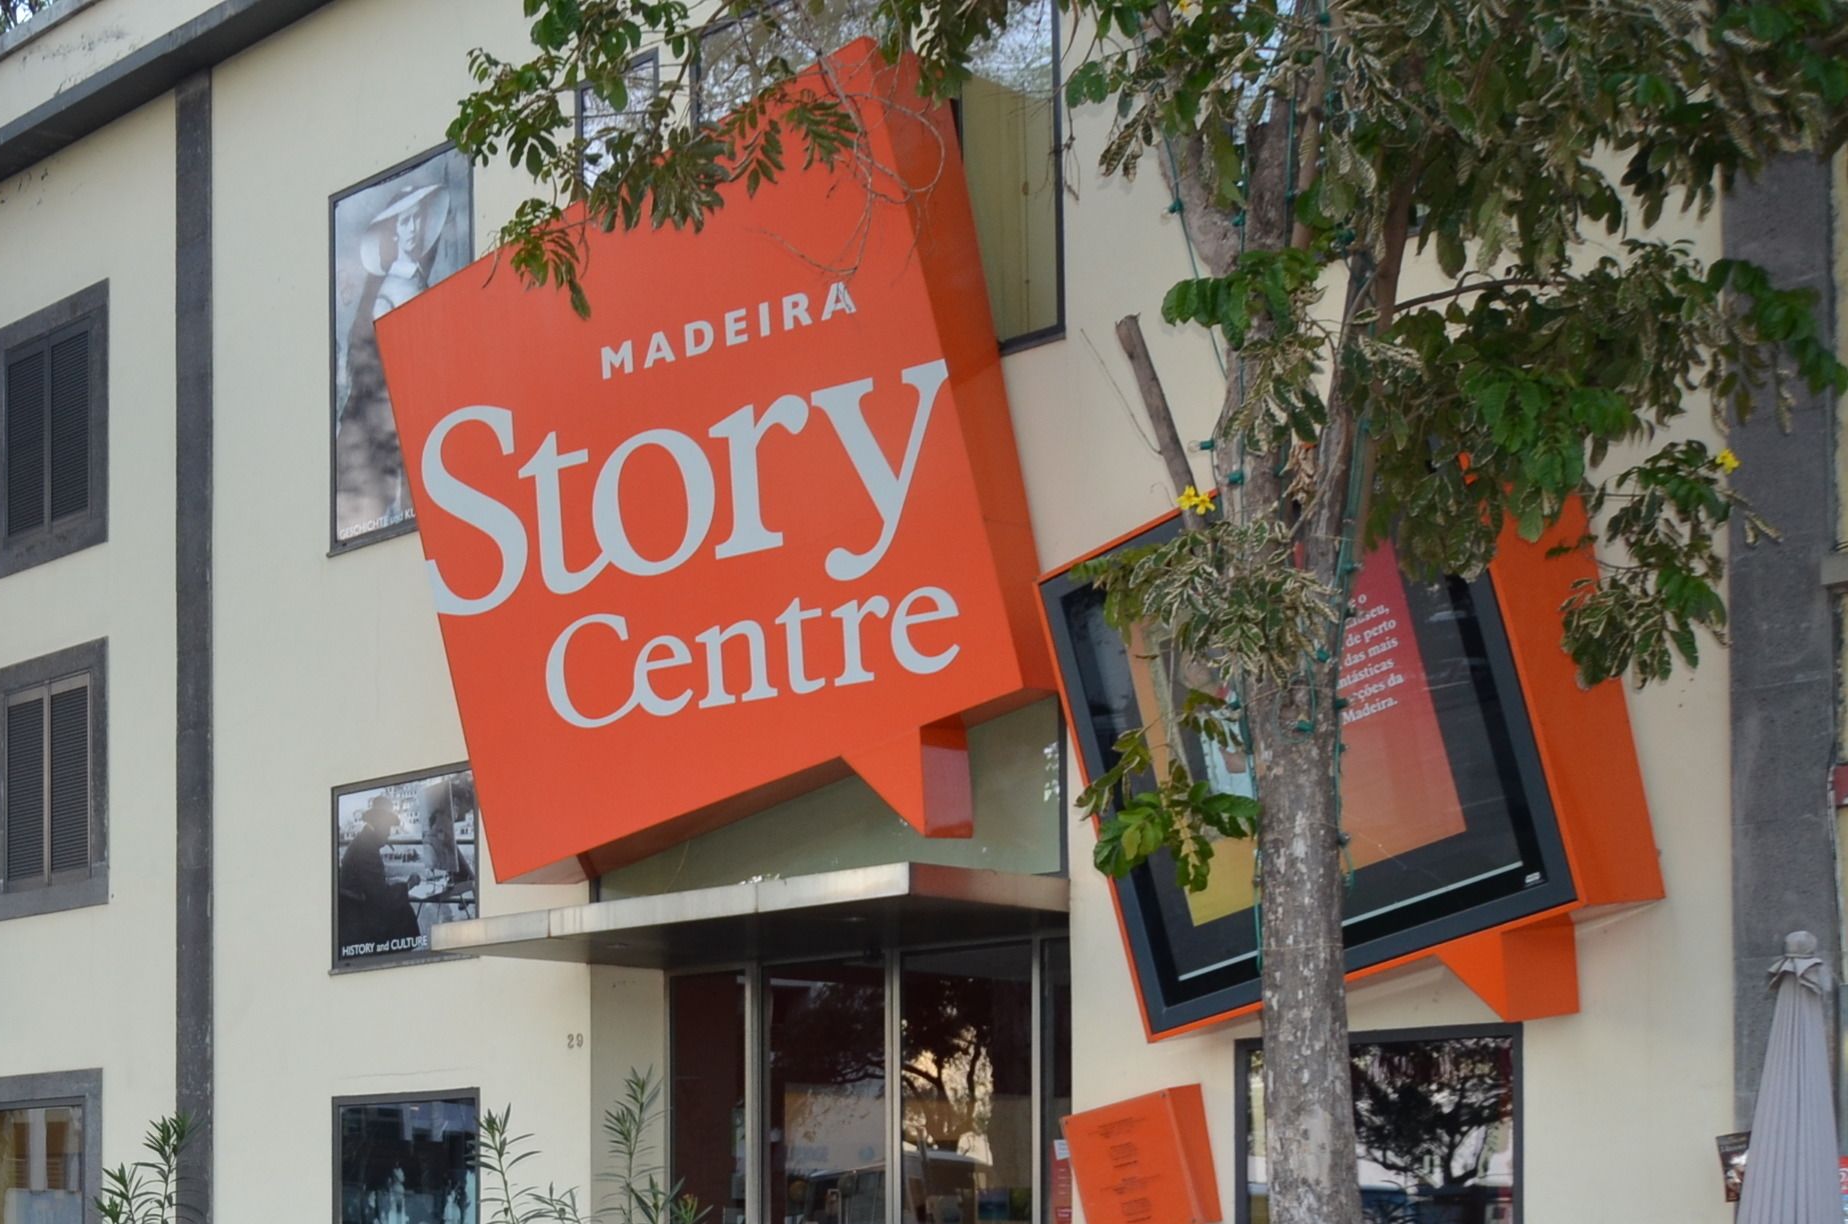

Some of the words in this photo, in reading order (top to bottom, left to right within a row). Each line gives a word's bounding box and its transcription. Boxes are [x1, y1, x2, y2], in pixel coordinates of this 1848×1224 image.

[601, 281, 857, 379] MADEIRA
[421, 358, 949, 616] Story
[545, 586, 961, 729] Centre
[342, 942, 375, 957] HISTORY
[376, 941, 389, 952] and
[391, 936, 428, 950] CULTURE
